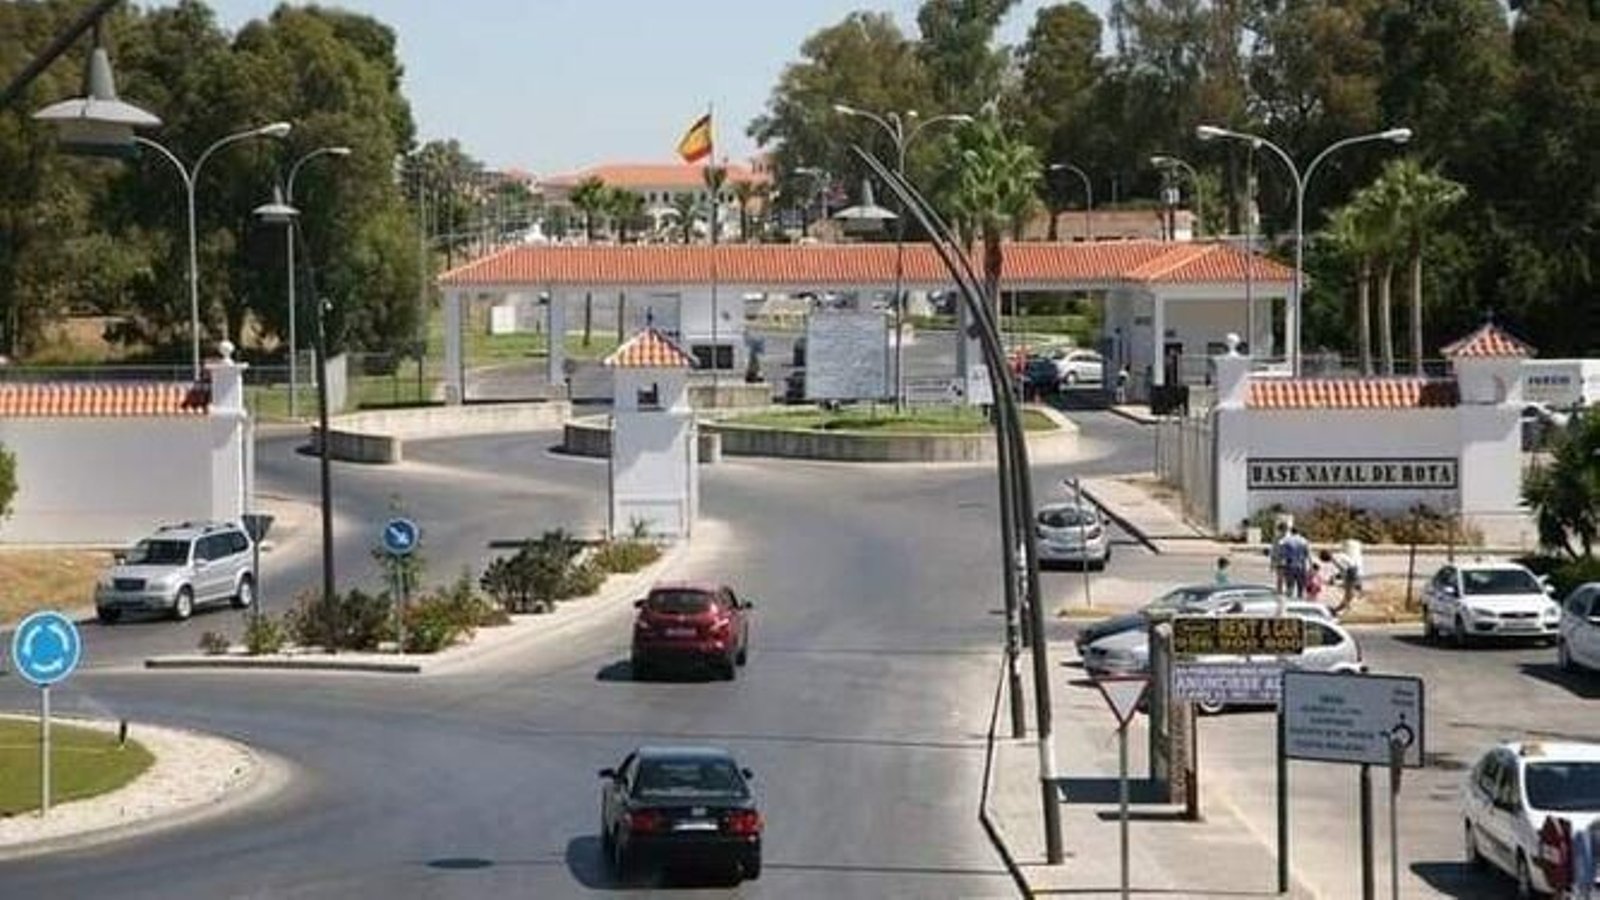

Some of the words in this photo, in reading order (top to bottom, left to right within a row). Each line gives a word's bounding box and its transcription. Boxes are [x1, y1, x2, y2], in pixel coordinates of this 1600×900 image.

[1253, 465, 1301, 482] BASE
[1306, 465, 1368, 482] NAVAL
[1372, 465, 1398, 482] DE
[1402, 465, 1452, 482] ROTA
[1219, 619, 1257, 636] RENT
